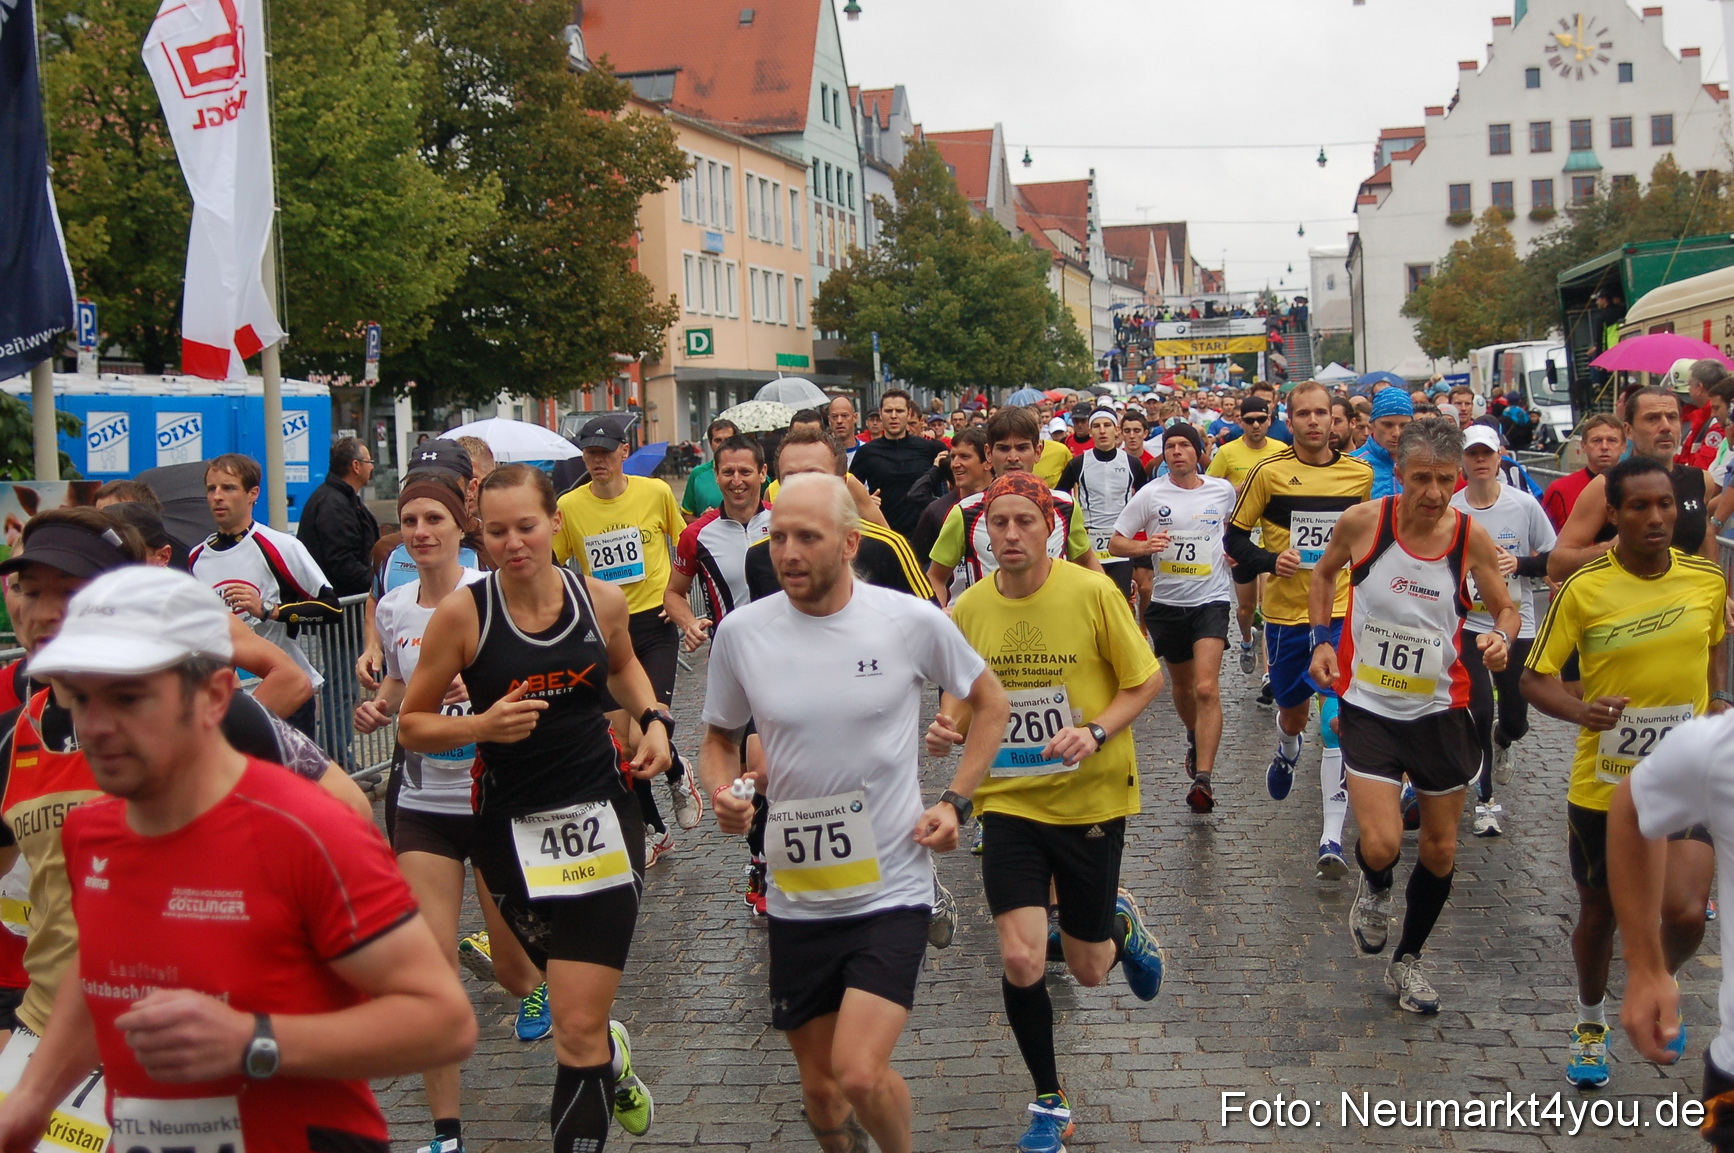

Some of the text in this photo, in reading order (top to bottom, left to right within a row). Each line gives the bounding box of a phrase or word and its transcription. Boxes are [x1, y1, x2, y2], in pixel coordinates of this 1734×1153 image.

[80, 308, 93, 342] P
[689, 332, 709, 353] D
[1191, 341, 1229, 352] START
[602, 534, 629, 545] Neumarkt
[591, 541, 638, 568] 2818
[1174, 543, 1196, 561] 73
[603, 568, 633, 580] Henning
[1171, 565, 1197, 574] Gunder
[1409, 585, 1440, 597] TELMEKOM
[1365, 624, 1431, 645] PARTL Neumarkt
[988, 653, 1077, 666] MMERZBANK
[1378, 641, 1425, 674] 161
[505, 662, 597, 695] ABEX
[993, 667, 1063, 678] harity Stadtlauf
[1001, 680, 1053, 689] Schwandorf
[1381, 674, 1408, 690] Erich
[1002, 708, 1065, 743] 260
[1637, 714, 1679, 724] Neumarkt
[1011, 750, 1051, 764] Rolan
[1602, 759, 1634, 775] Girm
[551, 802, 597, 821] Neumarkt
[768, 805, 847, 823] PARTL Neumarkt
[540, 816, 606, 860] 462
[783, 820, 852, 864] 575
[562, 866, 596, 882] Anke
[113, 1117, 241, 1135] RTL Neumarkt
